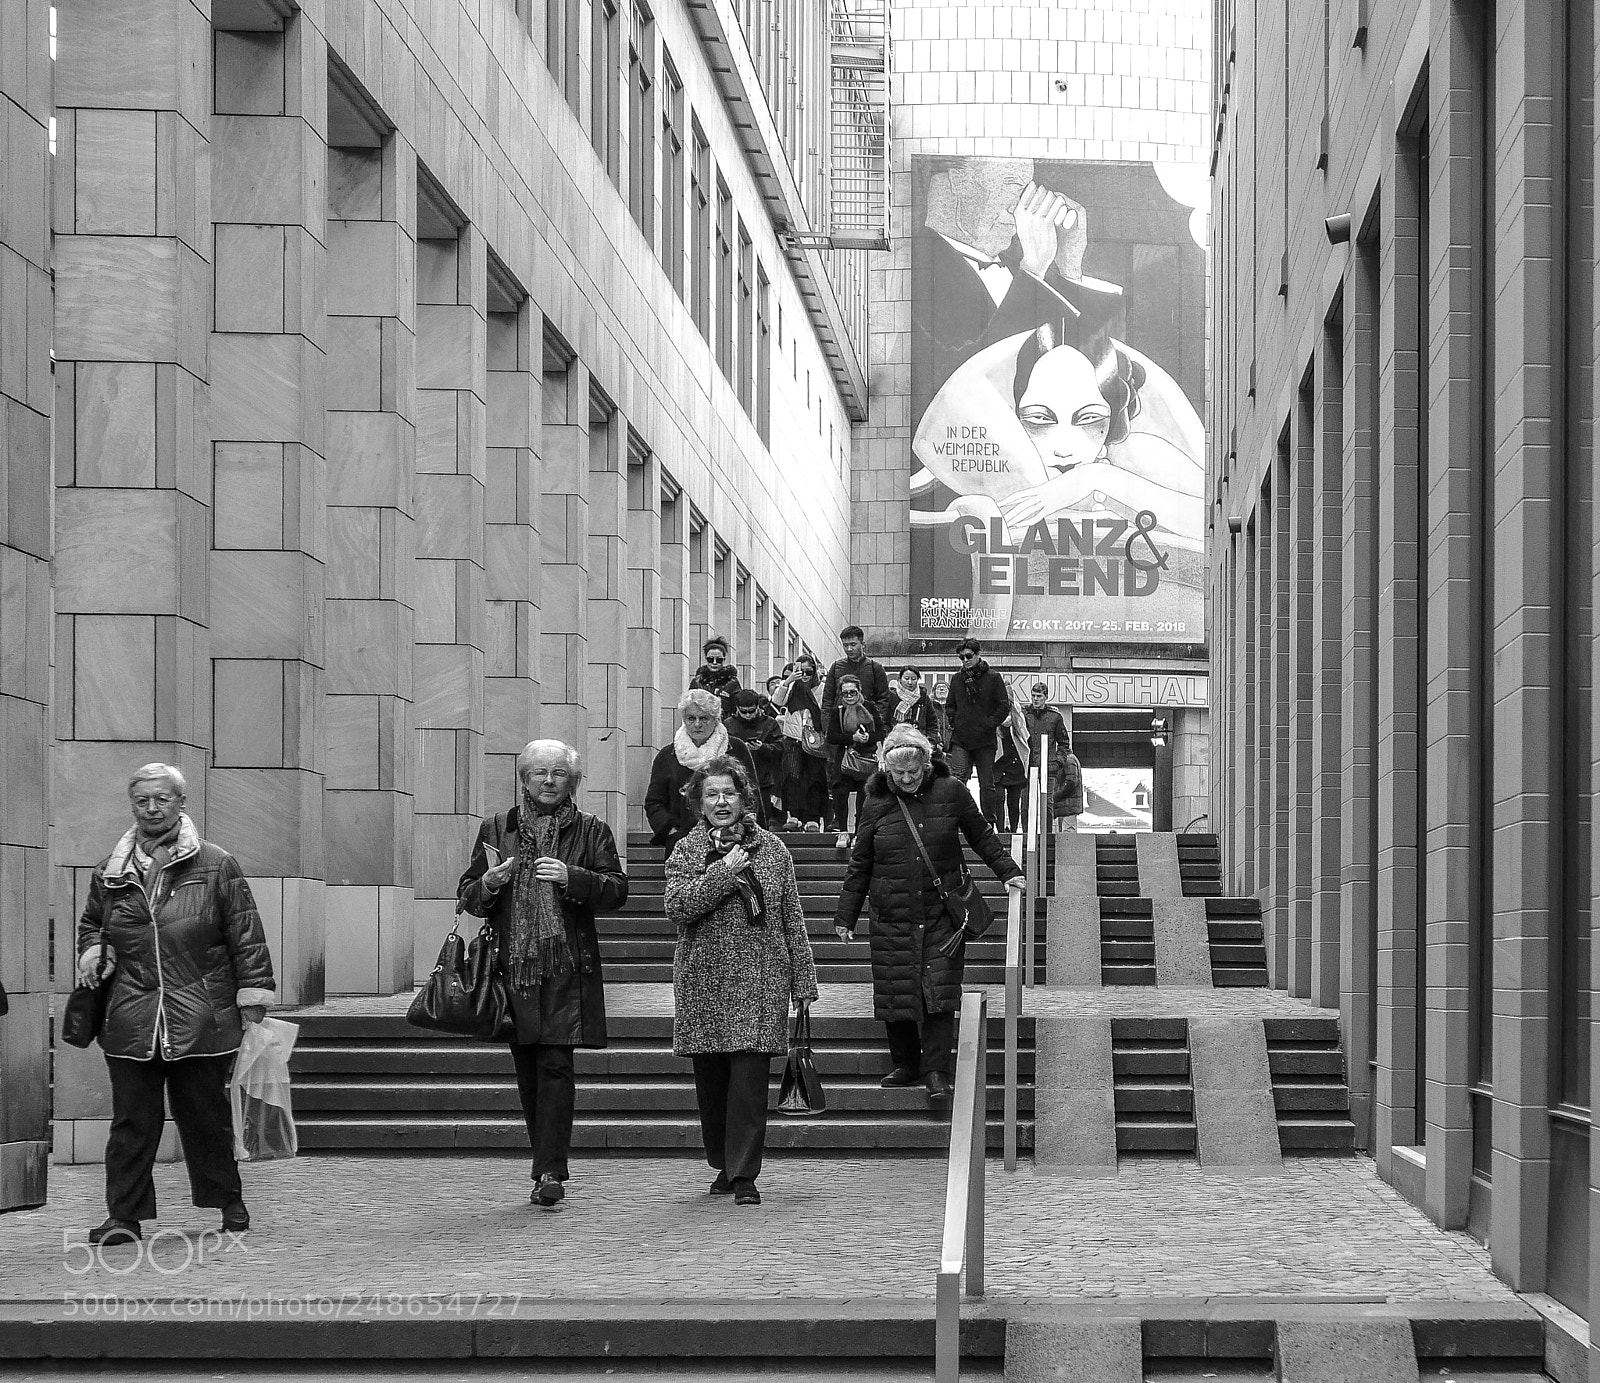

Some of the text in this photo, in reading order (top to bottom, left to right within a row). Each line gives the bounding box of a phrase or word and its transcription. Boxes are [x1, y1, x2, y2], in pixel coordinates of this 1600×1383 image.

[946, 425, 987, 440] IN DER
[932, 441, 1000, 456] WEIMARER
[951, 458, 1010, 473] REPUBLIK
[979, 556, 1160, 597] ELEND
[920, 597, 970, 609] SCHIRN
[920, 607, 1007, 619] KUNSTHALLE
[920, 617, 999, 629] FRANKFURT
[1012, 619, 1030, 631] 27.
[1032, 619, 1063, 631] OKT.
[1102, 621, 1122, 632] 25.
[1125, 621, 1154, 632] FEB.
[1156, 622, 1186, 632] 2018
[1003, 674, 1209, 705] KUNSTHAL
